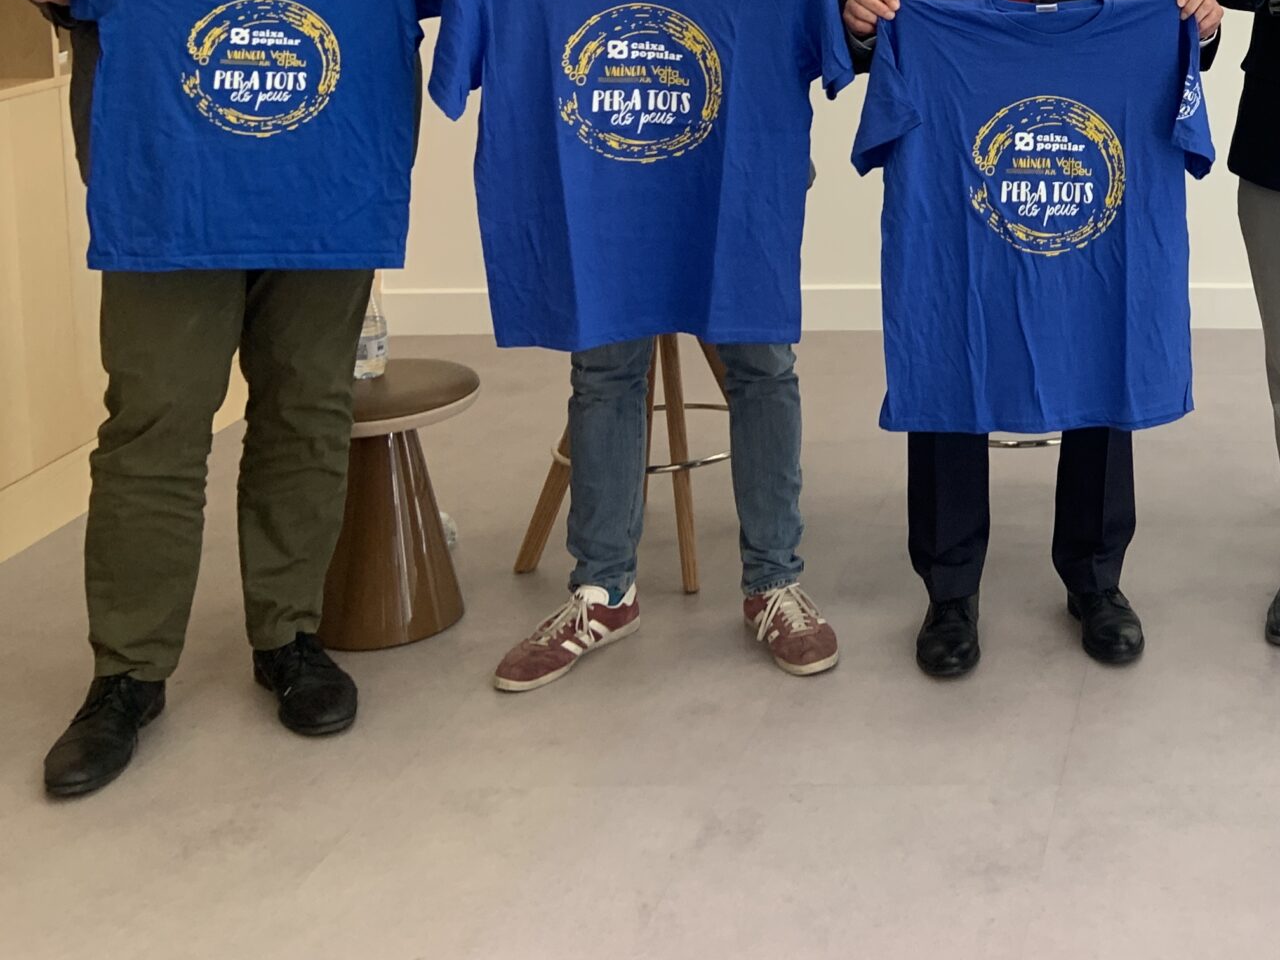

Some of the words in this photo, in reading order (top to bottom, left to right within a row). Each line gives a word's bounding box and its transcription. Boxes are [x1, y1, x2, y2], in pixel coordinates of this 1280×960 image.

[252, 30, 284, 38] caixa
[252, 37, 301, 46] popular
[631, 41, 665, 51] caixa
[270, 50, 297, 59] Volta
[630, 50, 683, 61] popular
[651, 65, 679, 78] Volta
[213, 70, 244, 90] PER
[265, 71, 307, 91] TOTS
[255, 90, 291, 111] peus
[592, 90, 625, 113] PER
[647, 90, 691, 114] TOTS
[637, 112, 676, 134] peus
[1036, 133, 1068, 142] caixa
[1036, 141, 1085, 152] popular
[1056, 157, 1082, 168] Volta
[1001, 181, 1030, 203] PER
[1052, 181, 1093, 203] TOTS
[1043, 204, 1079, 227] peus
